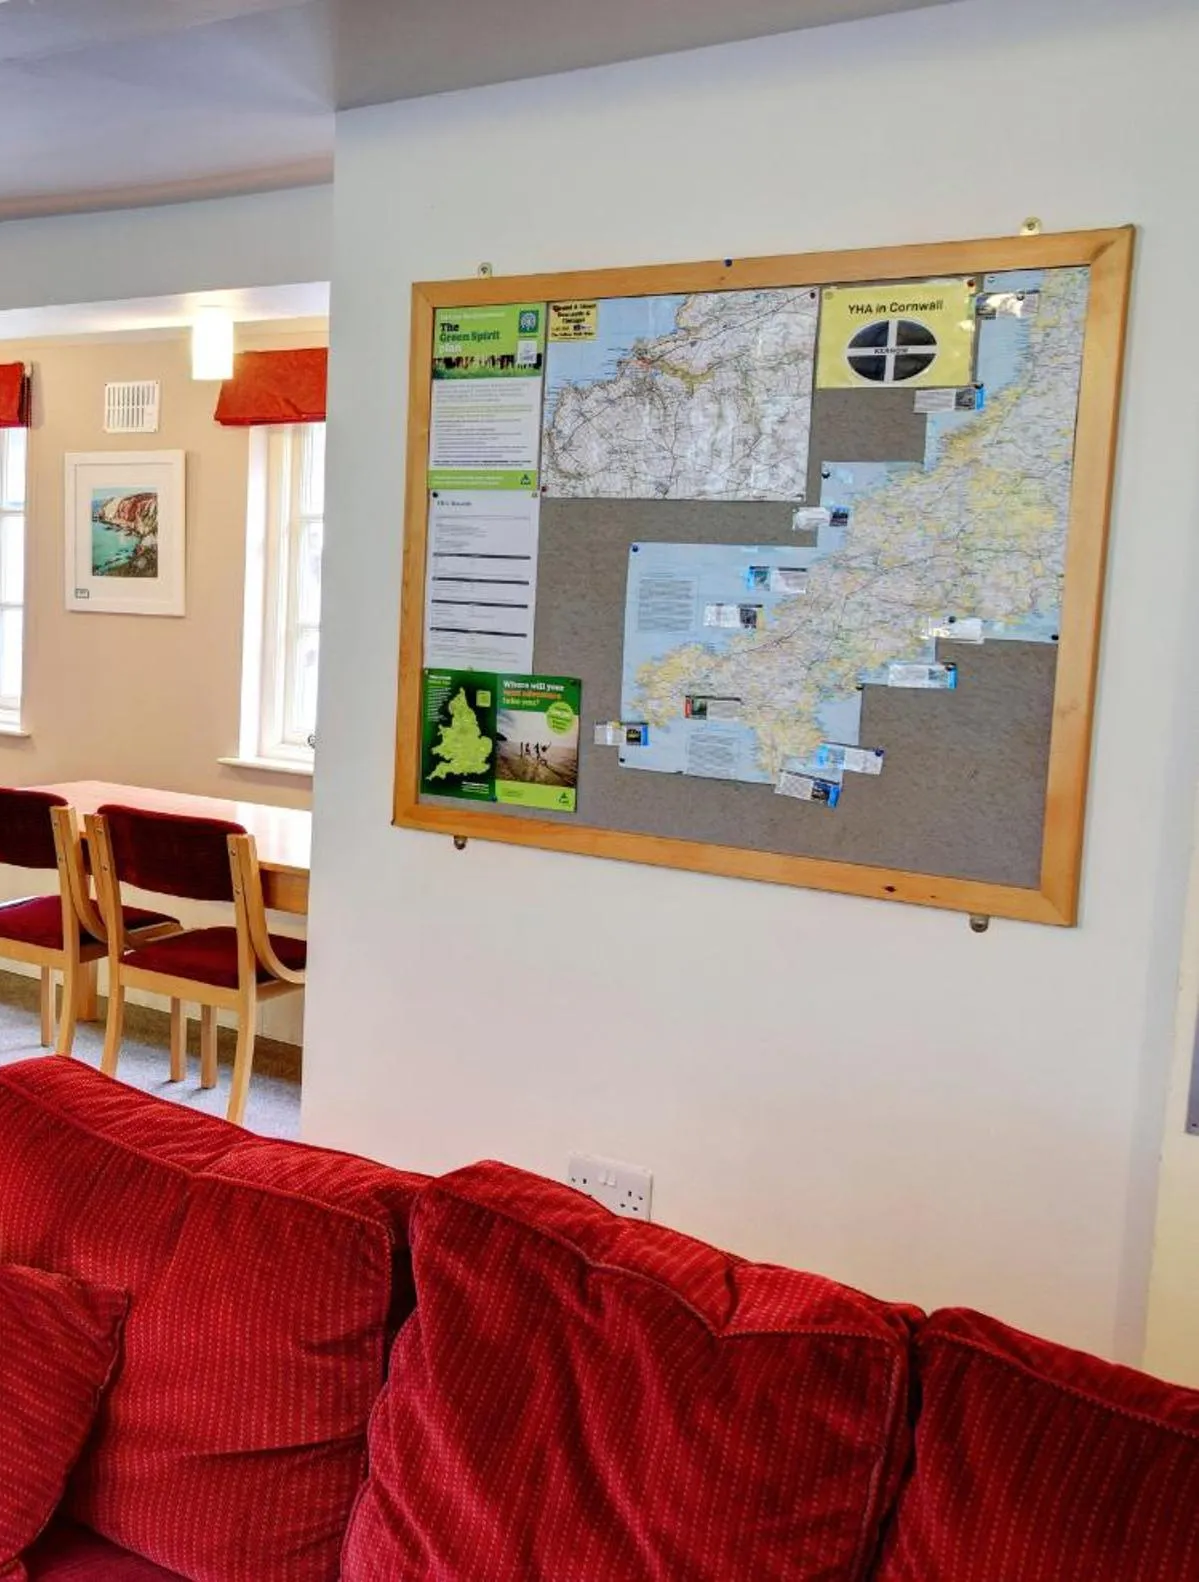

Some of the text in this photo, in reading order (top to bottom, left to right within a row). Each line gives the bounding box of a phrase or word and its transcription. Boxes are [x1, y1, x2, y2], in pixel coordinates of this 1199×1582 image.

[848, 300, 944, 314] YHA in Cornwall
[440, 322, 459, 332] The
[440, 329, 499, 342] Green Spirit
[503, 680, 529, 690] Where
